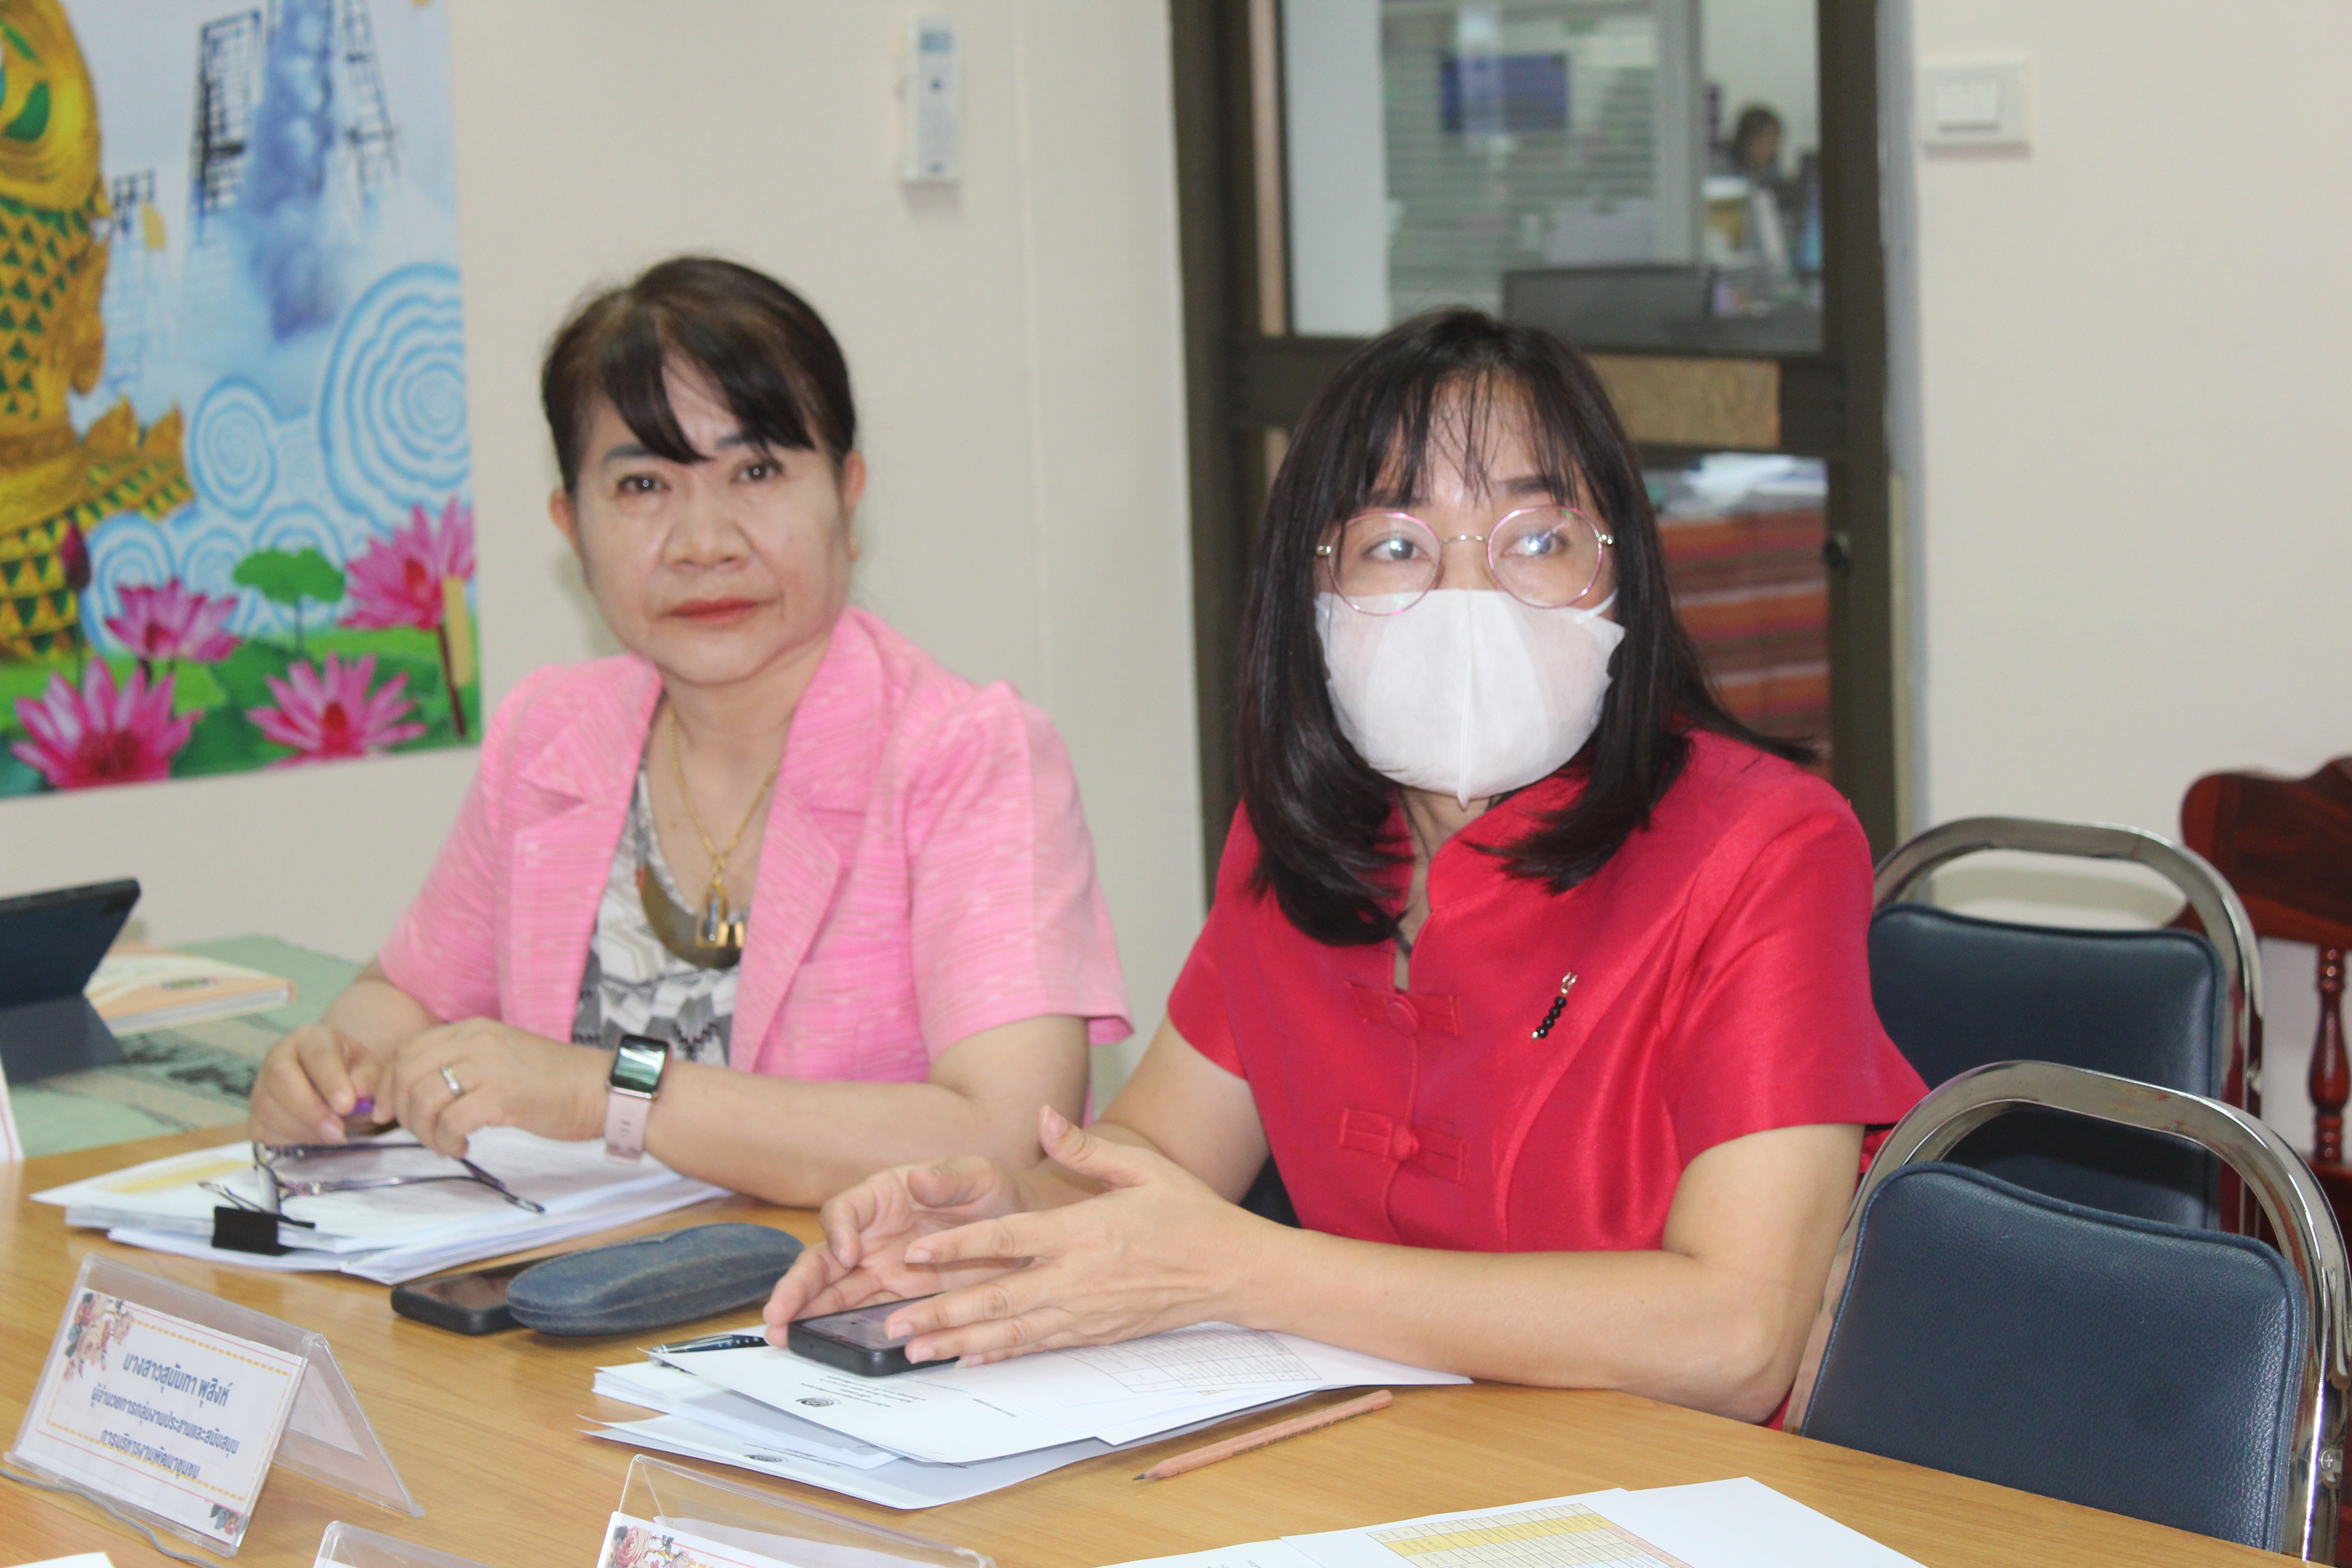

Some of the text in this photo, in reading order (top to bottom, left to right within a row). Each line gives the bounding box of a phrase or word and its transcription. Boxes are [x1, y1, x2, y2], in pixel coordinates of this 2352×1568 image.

[123, 1352, 198, 1395] นางสาวสุนันทา
